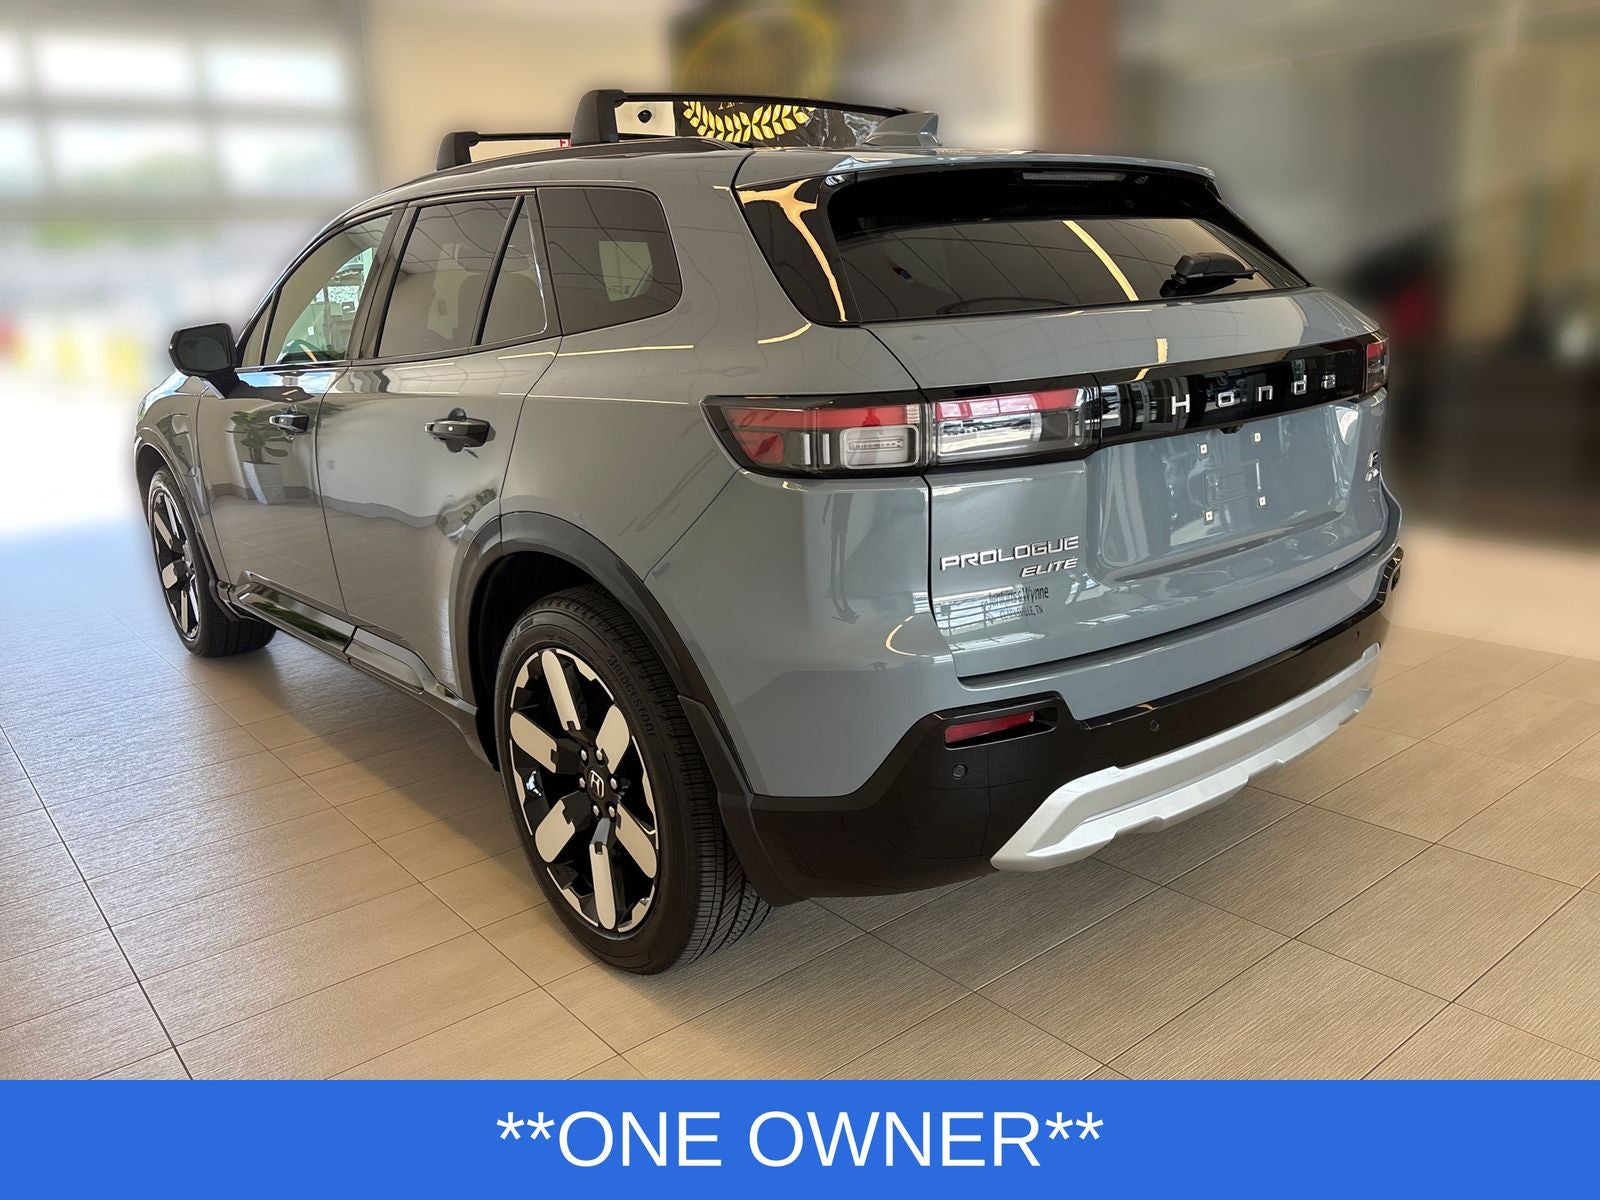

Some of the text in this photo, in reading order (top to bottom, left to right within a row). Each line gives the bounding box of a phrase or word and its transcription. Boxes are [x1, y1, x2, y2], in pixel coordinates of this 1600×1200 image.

[940, 535, 1080, 571] PROLOGUE
[1020, 557, 1079, 578] ELITE
[606, 654, 659, 740] BRIDGESTONE
